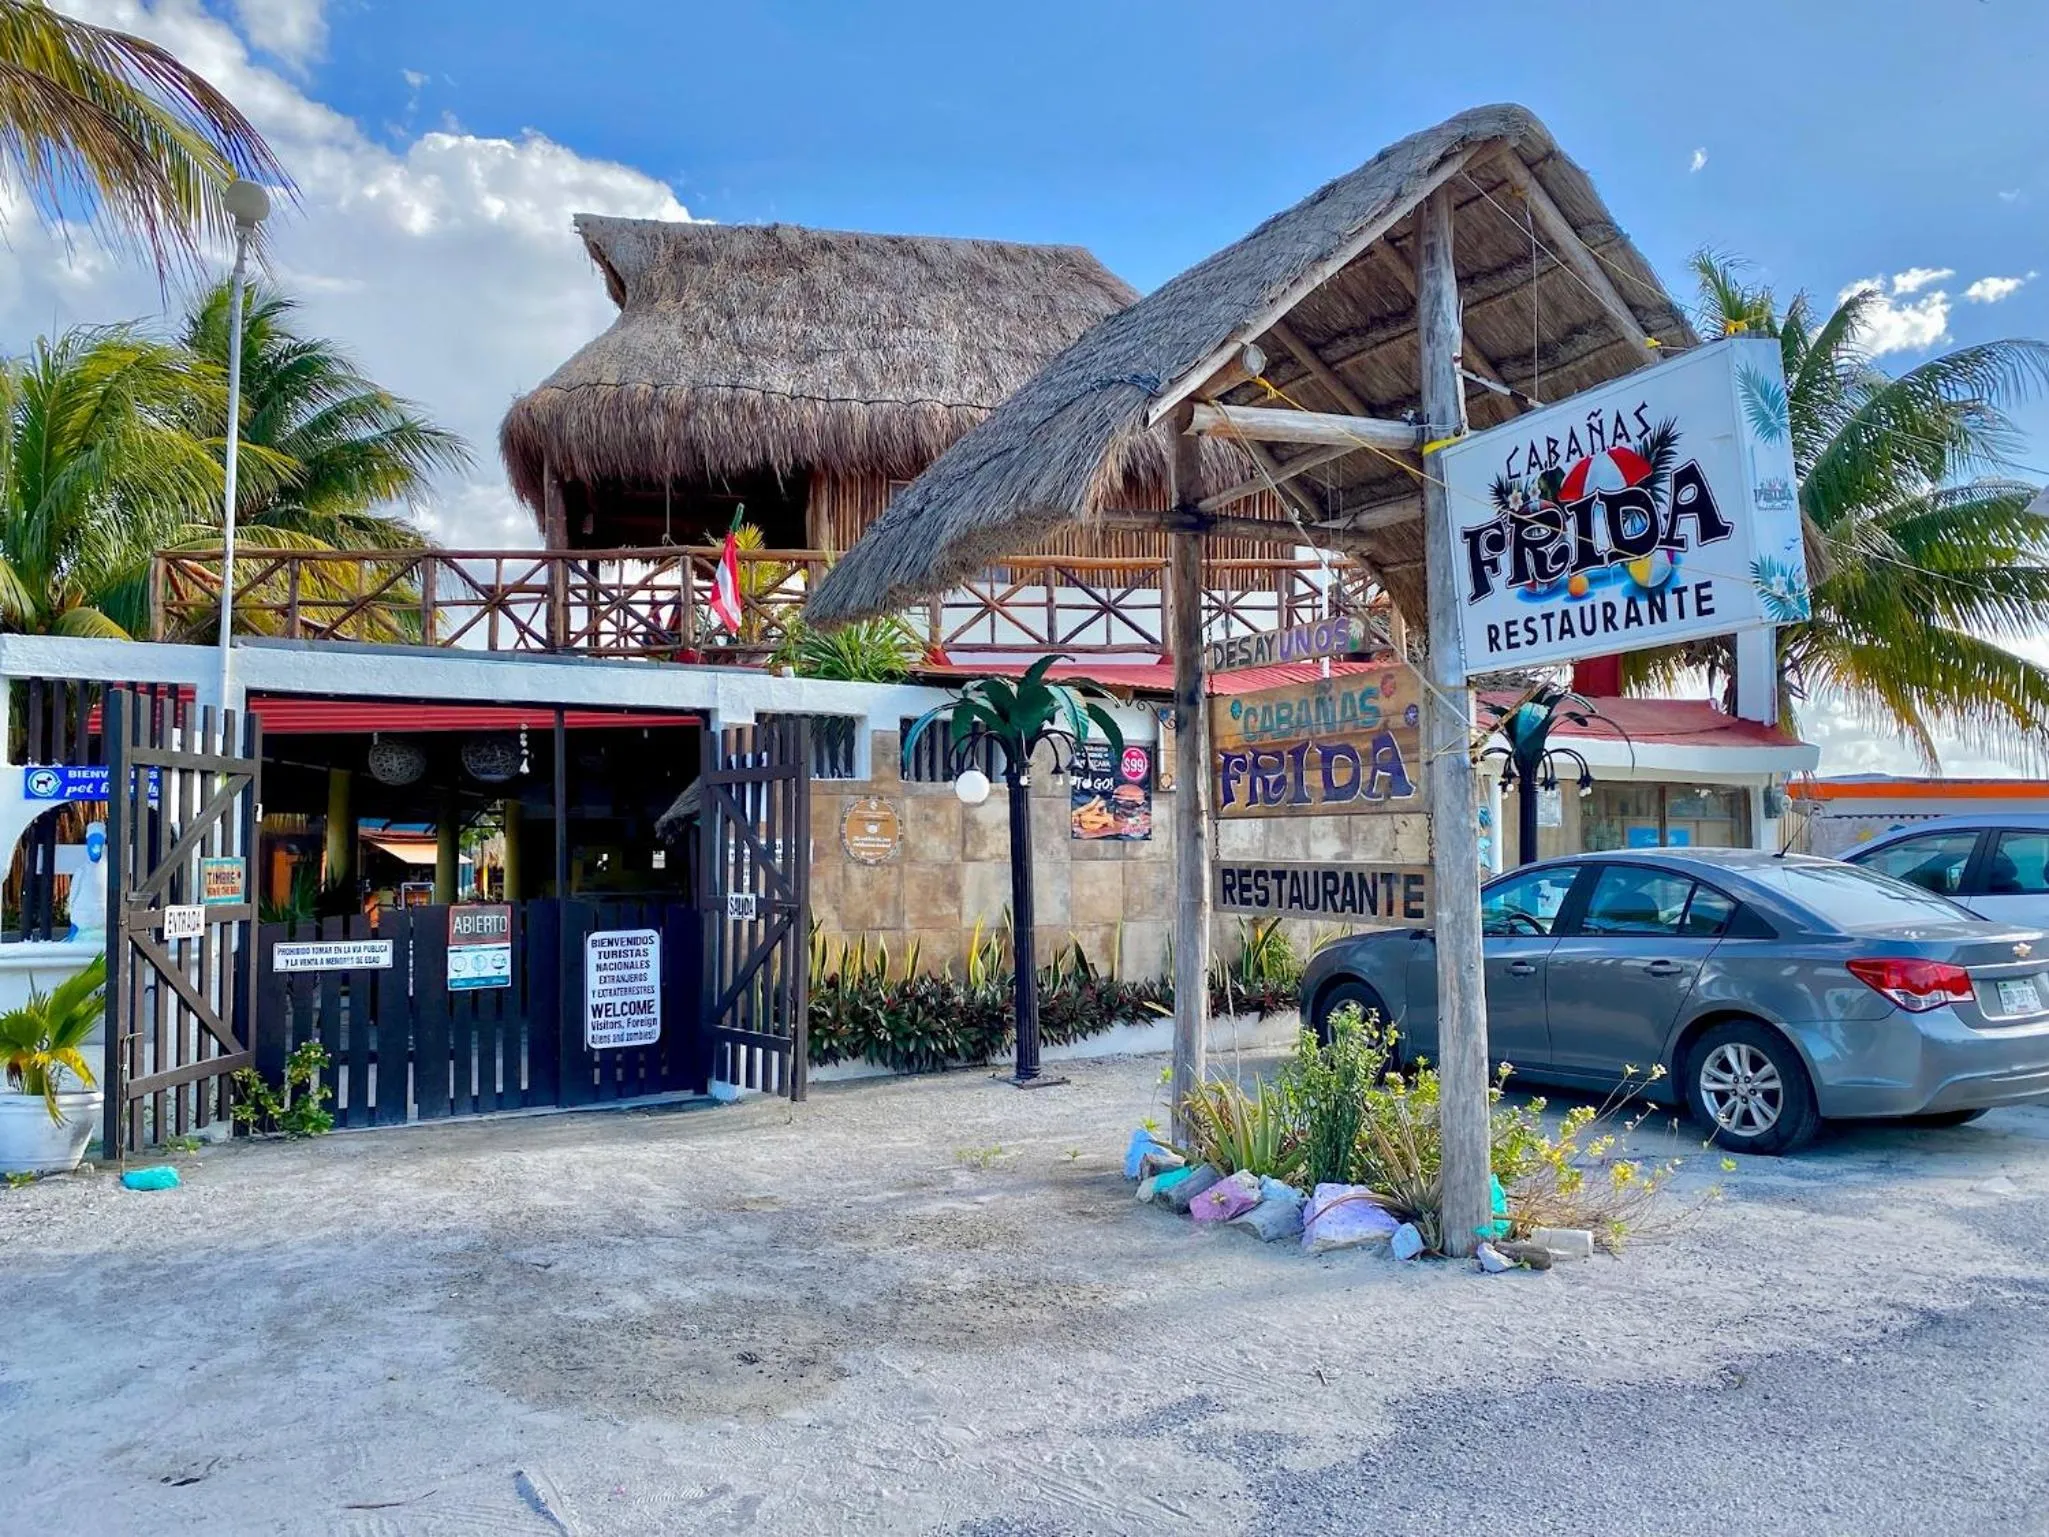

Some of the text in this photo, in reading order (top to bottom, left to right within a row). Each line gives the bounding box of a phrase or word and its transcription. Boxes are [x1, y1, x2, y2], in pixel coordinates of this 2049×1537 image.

[1506, 401, 1652, 480] CABAÑAS
[1461, 459, 1734, 605] FRIDA
[1487, 581, 1716, 653] RESTAURANTE
[1212, 616, 1348, 670] DESAYUNOS
[1243, 681, 1381, 741] CABAÑAS
[1124, 758, 1144, 773] $99
[1218, 730, 1417, 812] FRIDA
[64, 783, 94, 797] pet
[1094, 776, 1115, 791] GO!
[207, 871, 236, 885] TIMBRE
[1222, 868, 1426, 919] RESTAURANTE
[730, 896, 754, 917] SALIDA
[168, 911, 200, 934] ENTRADA
[453, 915, 508, 934] ABIERTO
[591, 935, 654, 948] BIENVENIDOS
[277, 947, 310, 955] PROHIBIDO
[312, 946, 332, 955] TOMAR
[334, 946, 342, 954] EN
[344, 945, 350, 953] LA
[598, 948, 649, 960] TURISTAS
[290, 958, 297, 966] LA
[300, 958, 318, 966] VENTA
[320, 957, 324, 965] A
[365, 956, 380, 964] EDAD
[596, 960, 650, 972] NACIONALES
[599, 973, 648, 984] EXTRANJEROS
[592, 985, 655, 998] Y EXTRATERRESTRES
[591, 999, 655, 1019] WELCOME
[591, 1017, 658, 1031] Visitors, Foreign
[591, 1034, 611, 1044] Aliens
[613, 1032, 624, 1043] and
